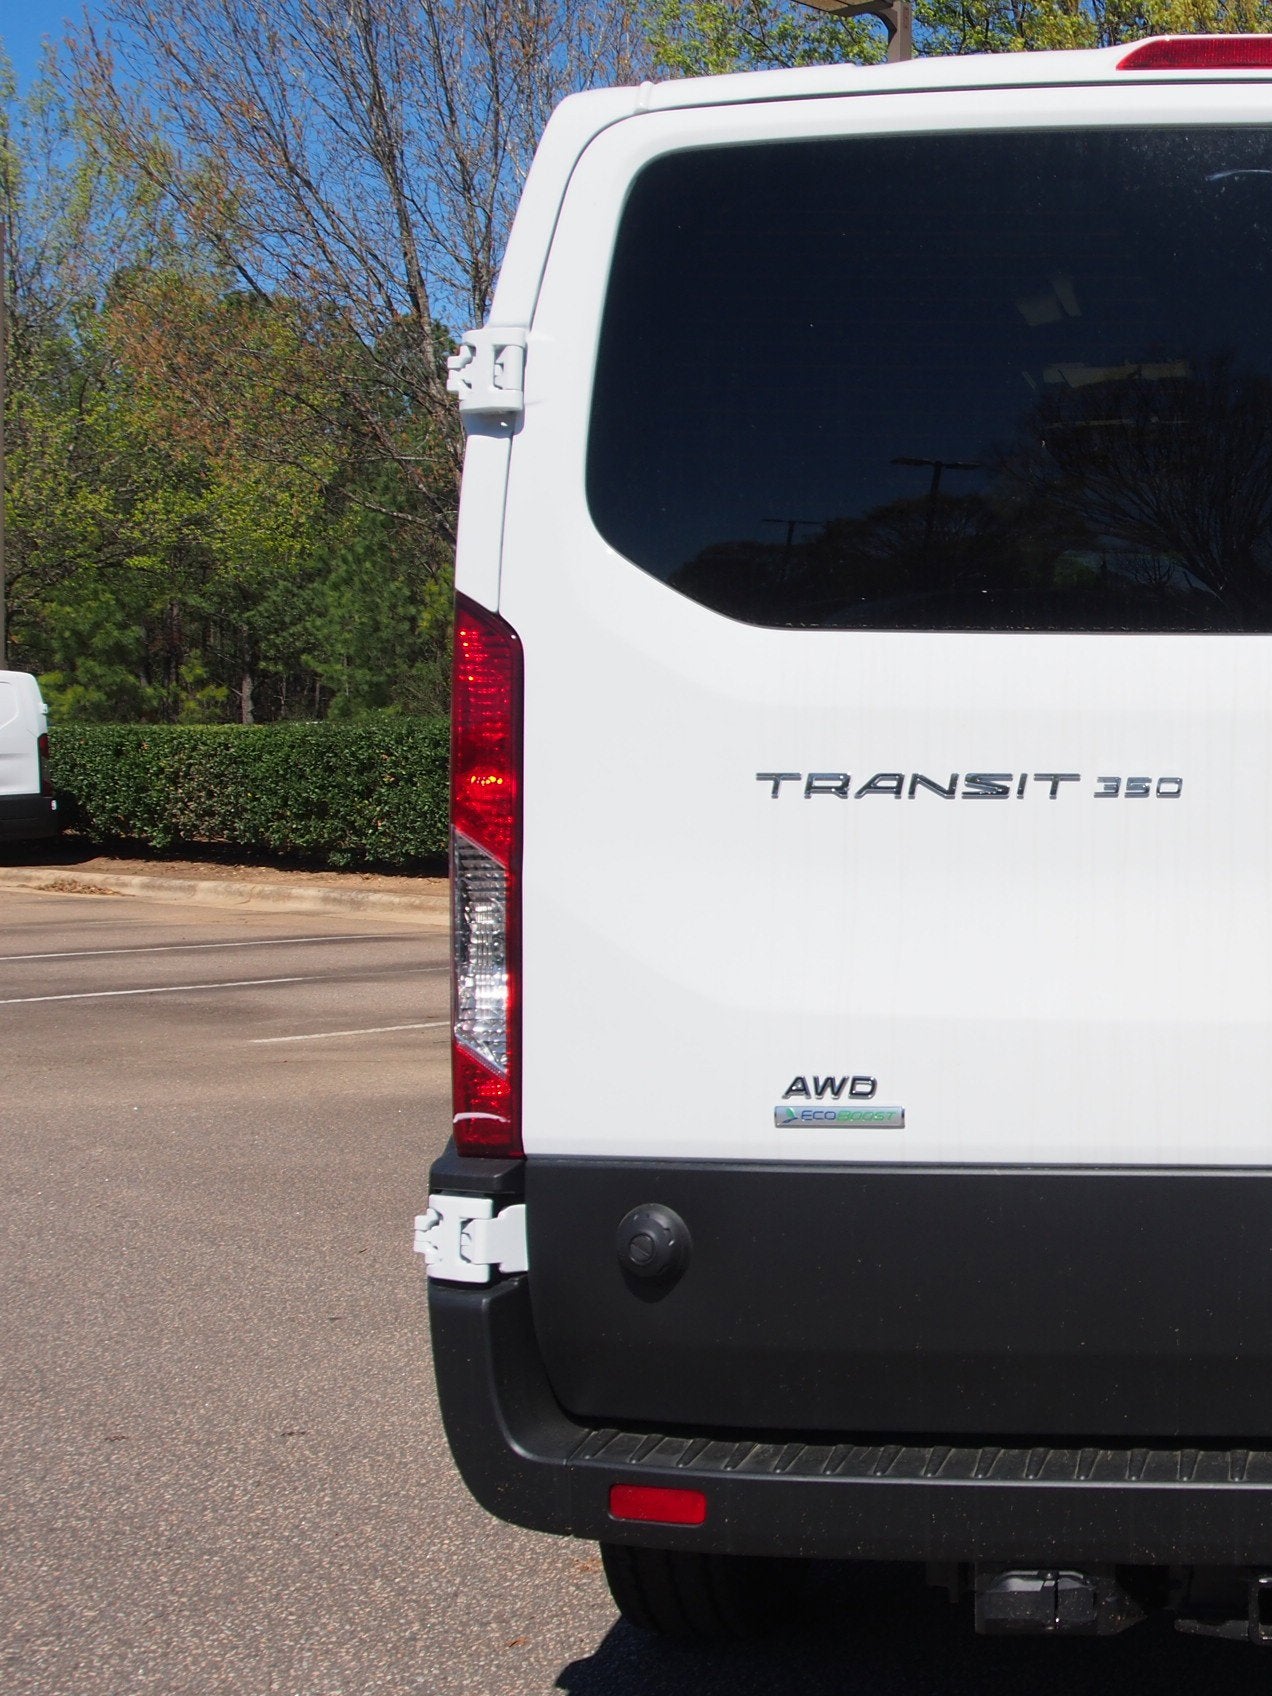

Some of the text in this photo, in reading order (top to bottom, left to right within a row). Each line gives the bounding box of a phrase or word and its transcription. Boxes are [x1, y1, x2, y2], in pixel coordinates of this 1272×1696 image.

[755, 772, 1184, 800] TRANSIT 350
[781, 1075, 878, 1100] AWD
[801, 1109, 896, 1121] ECOBOOST
